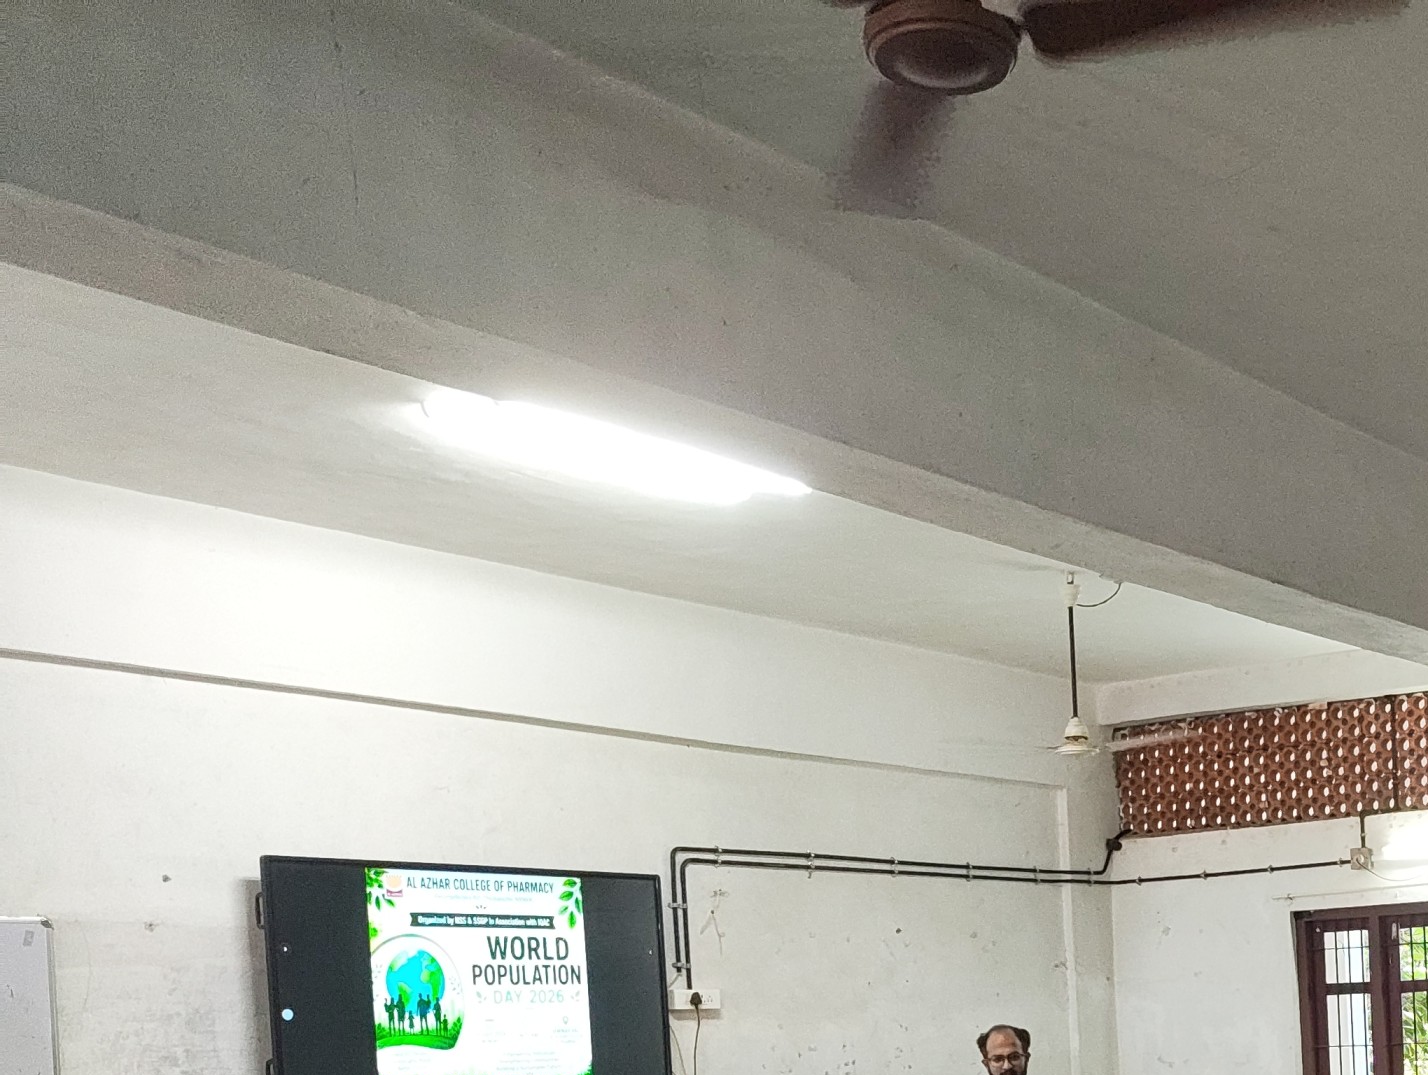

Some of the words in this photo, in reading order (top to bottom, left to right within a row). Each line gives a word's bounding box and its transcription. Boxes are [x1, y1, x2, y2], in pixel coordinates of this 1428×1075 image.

[406, 877, 417, 889] AL
[420, 877, 451, 890] AZHAR
[453, 878, 491, 892] COLLEGE
[494, 880, 504, 892] OF
[507, 881, 554, 894] PHARMACY
[447, 916, 454, 926] by
[486, 935, 569, 961] WORLD
[472, 964, 582, 986] POPULATION
[493, 990, 522, 1004] DAY
[529, 989, 564, 1004] 2026
